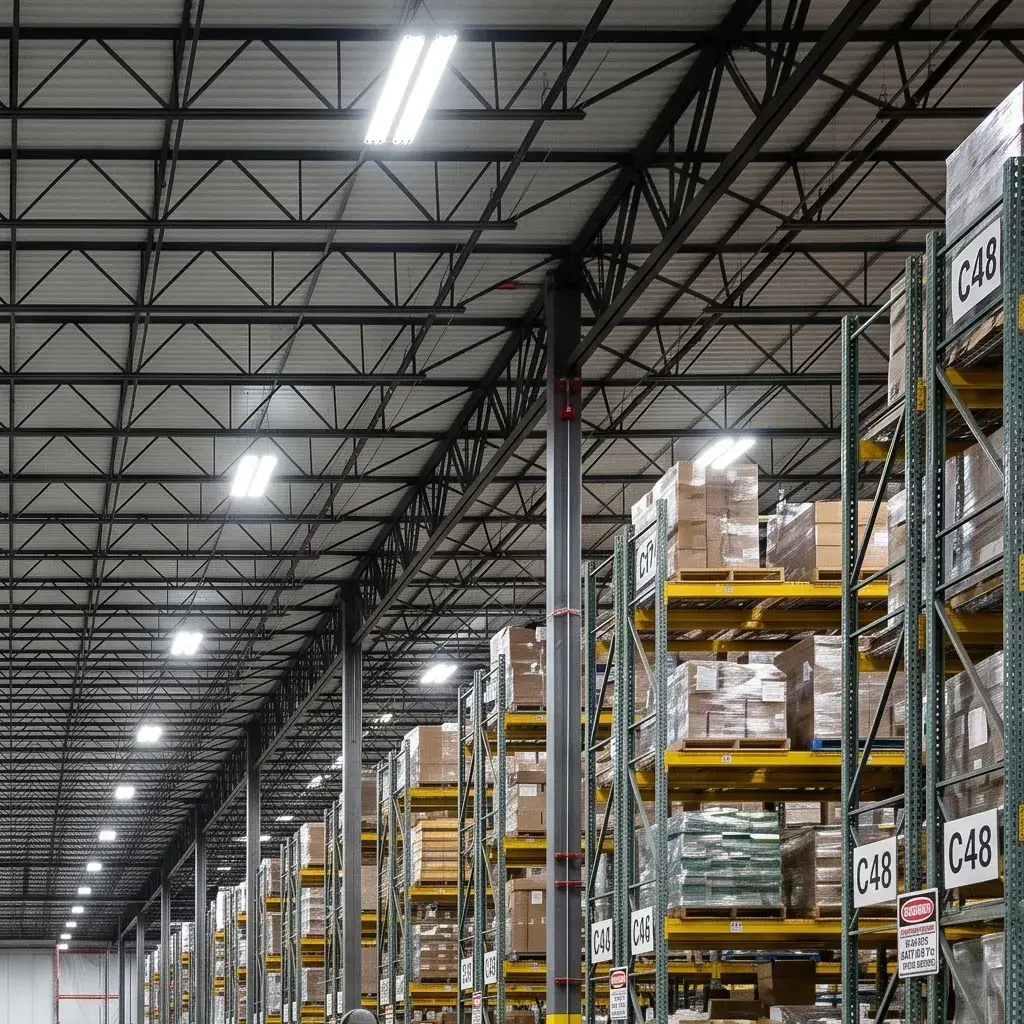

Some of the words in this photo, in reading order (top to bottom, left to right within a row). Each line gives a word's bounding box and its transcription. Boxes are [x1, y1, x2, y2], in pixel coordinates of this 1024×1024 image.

[958, 236, 997, 303] C48
[856, 850, 892, 895] C48
[948, 825, 992, 875] C48
